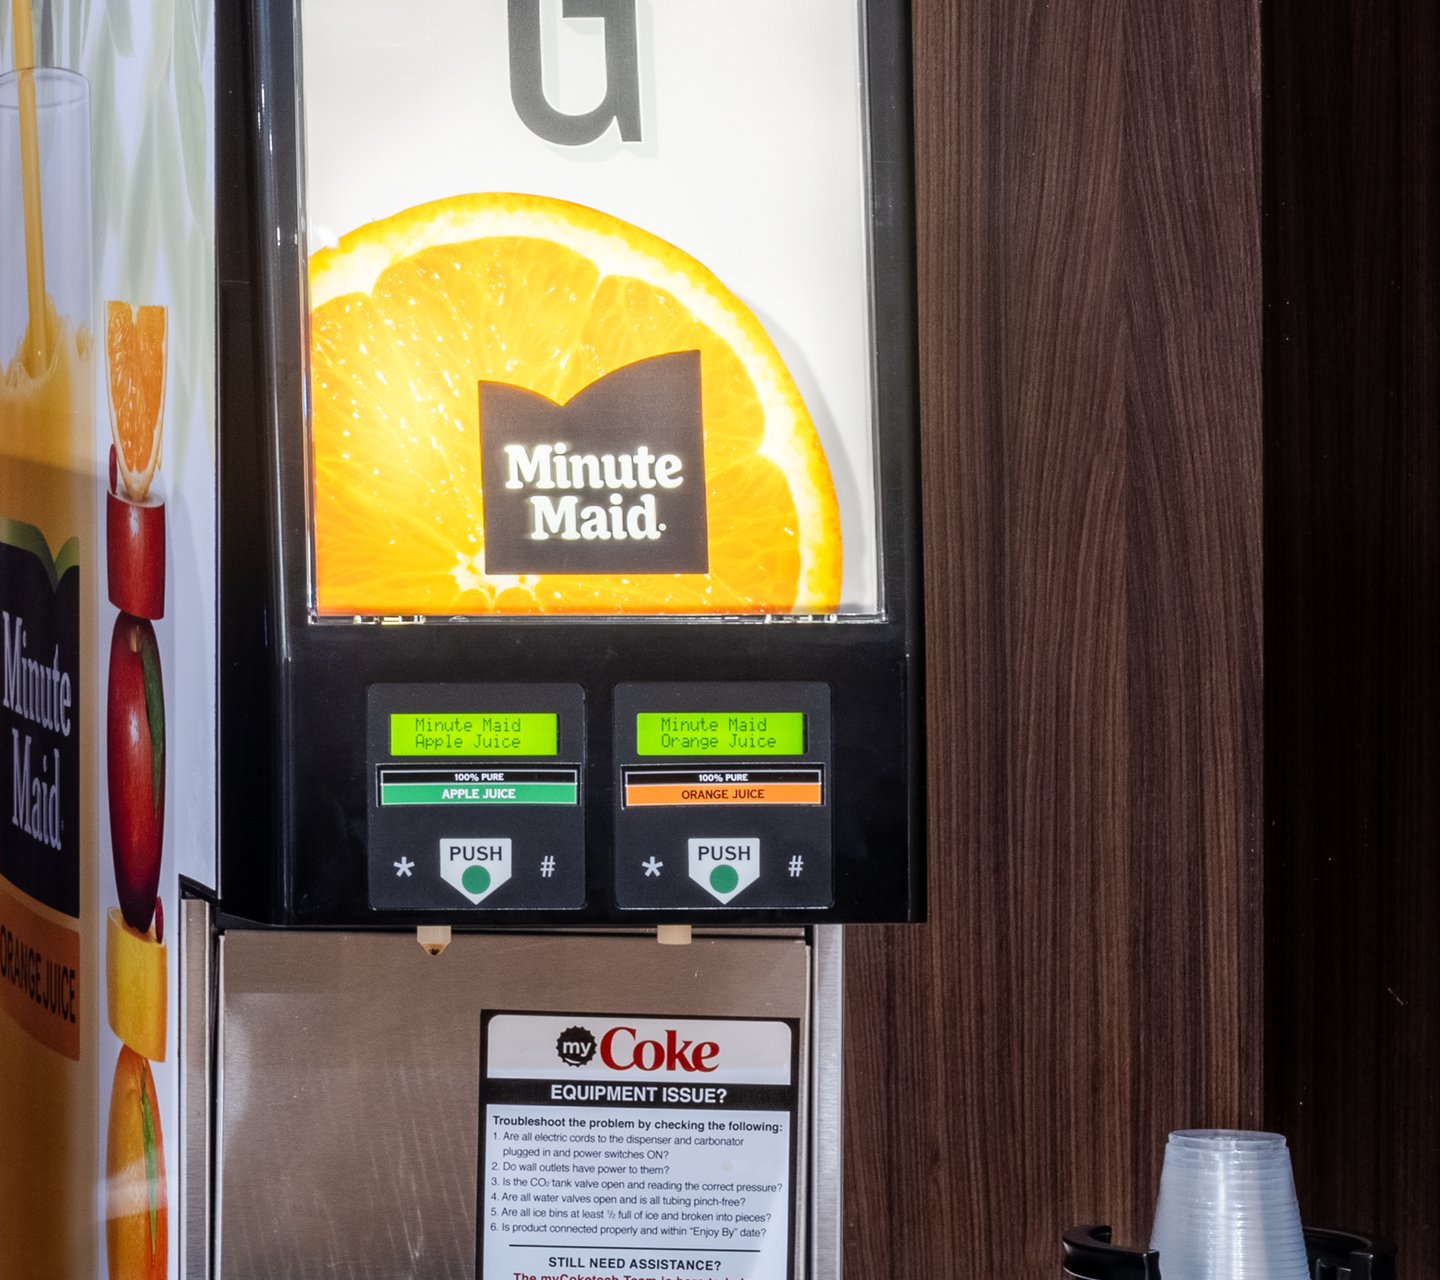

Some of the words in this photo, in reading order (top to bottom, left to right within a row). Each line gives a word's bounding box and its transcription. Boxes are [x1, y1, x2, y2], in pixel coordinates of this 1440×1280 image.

[504, 442, 684, 490] Minute
[530, 495, 660, 540] Maid
[2, 610, 71, 736] Minute
[415, 717, 472, 732] Minute
[482, 717, 521, 732] Maid
[661, 717, 719, 732] Minute
[728, 717, 767, 732] Maid
[415, 733, 463, 750] Apple
[473, 733, 521, 748] Juice
[661, 733, 719, 750] Orange
[728, 733, 776, 748] Juice
[454, 773, 479, 782] 100%
[481, 773, 504, 782] PURE
[699, 773, 723, 782] 100%
[726, 773, 749, 782] PURE
[12, 728, 61, 851] Maid
[442, 788, 480, 799] APPLE
[482, 788, 516, 799] JUICE
[681, 789, 728, 799] ORANGE
[732, 789, 764, 799] JUICE
[450, 845, 502, 861] PUSH
[698, 845, 750, 861] PUSH
[0, 924, 41, 1004] ORANGE
[43, 959, 76, 1024] JUICE
[562, 1041, 592, 1057] my
[600, 1026, 720, 1073] Coke
[551, 1084, 658, 1102] EQUIPMENT
[662, 1086, 727, 1103] ISSUE?
[492, 1115, 565, 1127] Troubleshoot
[568, 1117, 586, 1127] the
[589, 1118, 634, 1130] problem
[638, 1119, 651, 1131] by
[654, 1119, 704, 1132] checking
[708, 1120, 725, 1131] the
[728, 1121, 782, 1134] following:
[493, 1131, 499, 1140] 1.
[502, 1131, 519, 1141] Are
[521, 1132, 532, 1141] all
[534, 1132, 567, 1142] electric
[569, 1133, 595, 1143] cords
[597, 1134, 607, 1143] to
[609, 1134, 624, 1144] the
[625, 1134, 671, 1146] dispenser
[673, 1136, 692, 1145] and
[693, 1136, 744, 1146] carbonator
[502, 1146, 540, 1158] plugged
[552, 1148, 571, 1157] and
[573, 1150, 602, 1159] power
[604, 1149, 644, 1159] switches
[646, 1149, 669, 1159] ON?
[491, 1161, 500, 1171] 2.
[503, 1161, 516, 1171] Do
[518, 1162, 537, 1171] wall
[539, 1162, 570, 1173] outlets
[572, 1163, 595, 1173] have
[597, 1165, 626, 1175] power
[628, 1165, 638, 1174] to
[640, 1165, 670, 1175] them?
[548, 1256, 585, 1268] STILL
[589, 1257, 625, 1269] NEED
[629, 1258, 721, 1271] ASSISTANCE?
